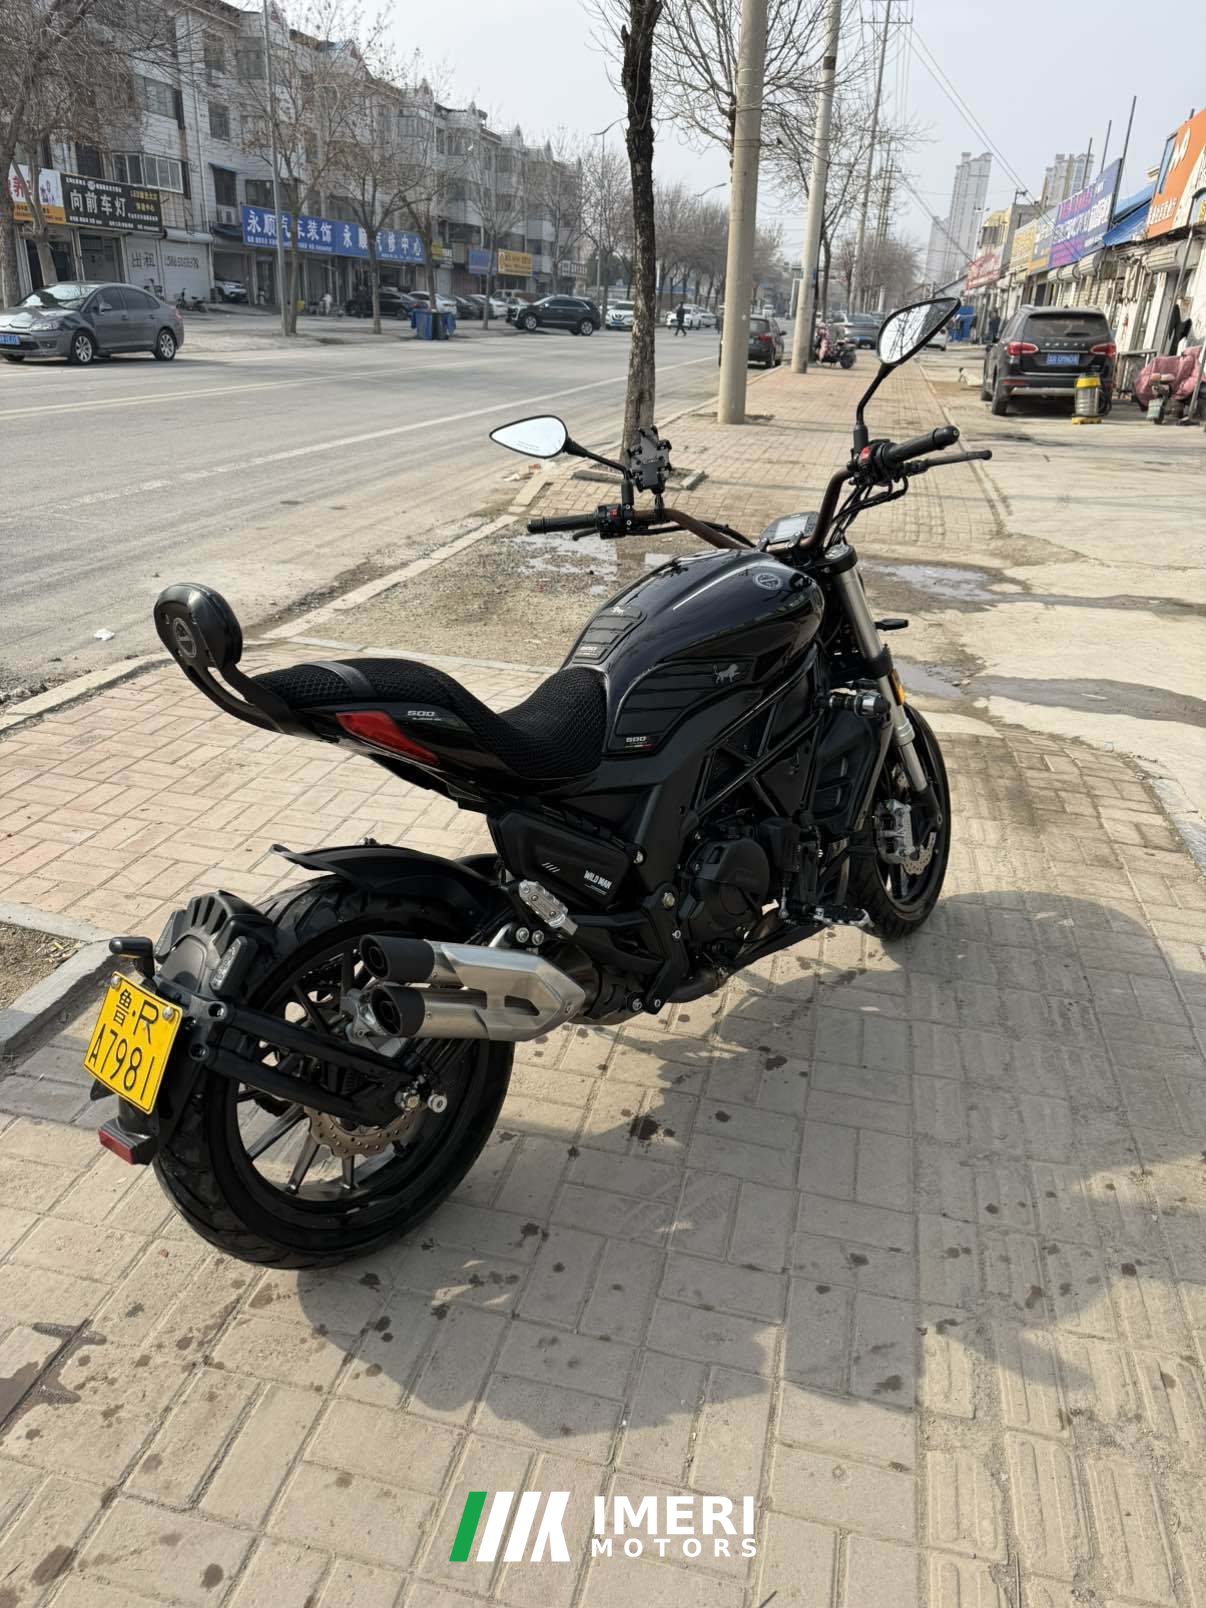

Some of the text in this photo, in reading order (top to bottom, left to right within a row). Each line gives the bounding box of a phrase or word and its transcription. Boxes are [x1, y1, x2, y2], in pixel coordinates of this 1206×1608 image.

[70, 189, 126, 217] 向前车灯
[583, 870, 600, 883] WILD
[597, 876, 612, 889] MAN
[88, 1023, 156, 1101] A7981
